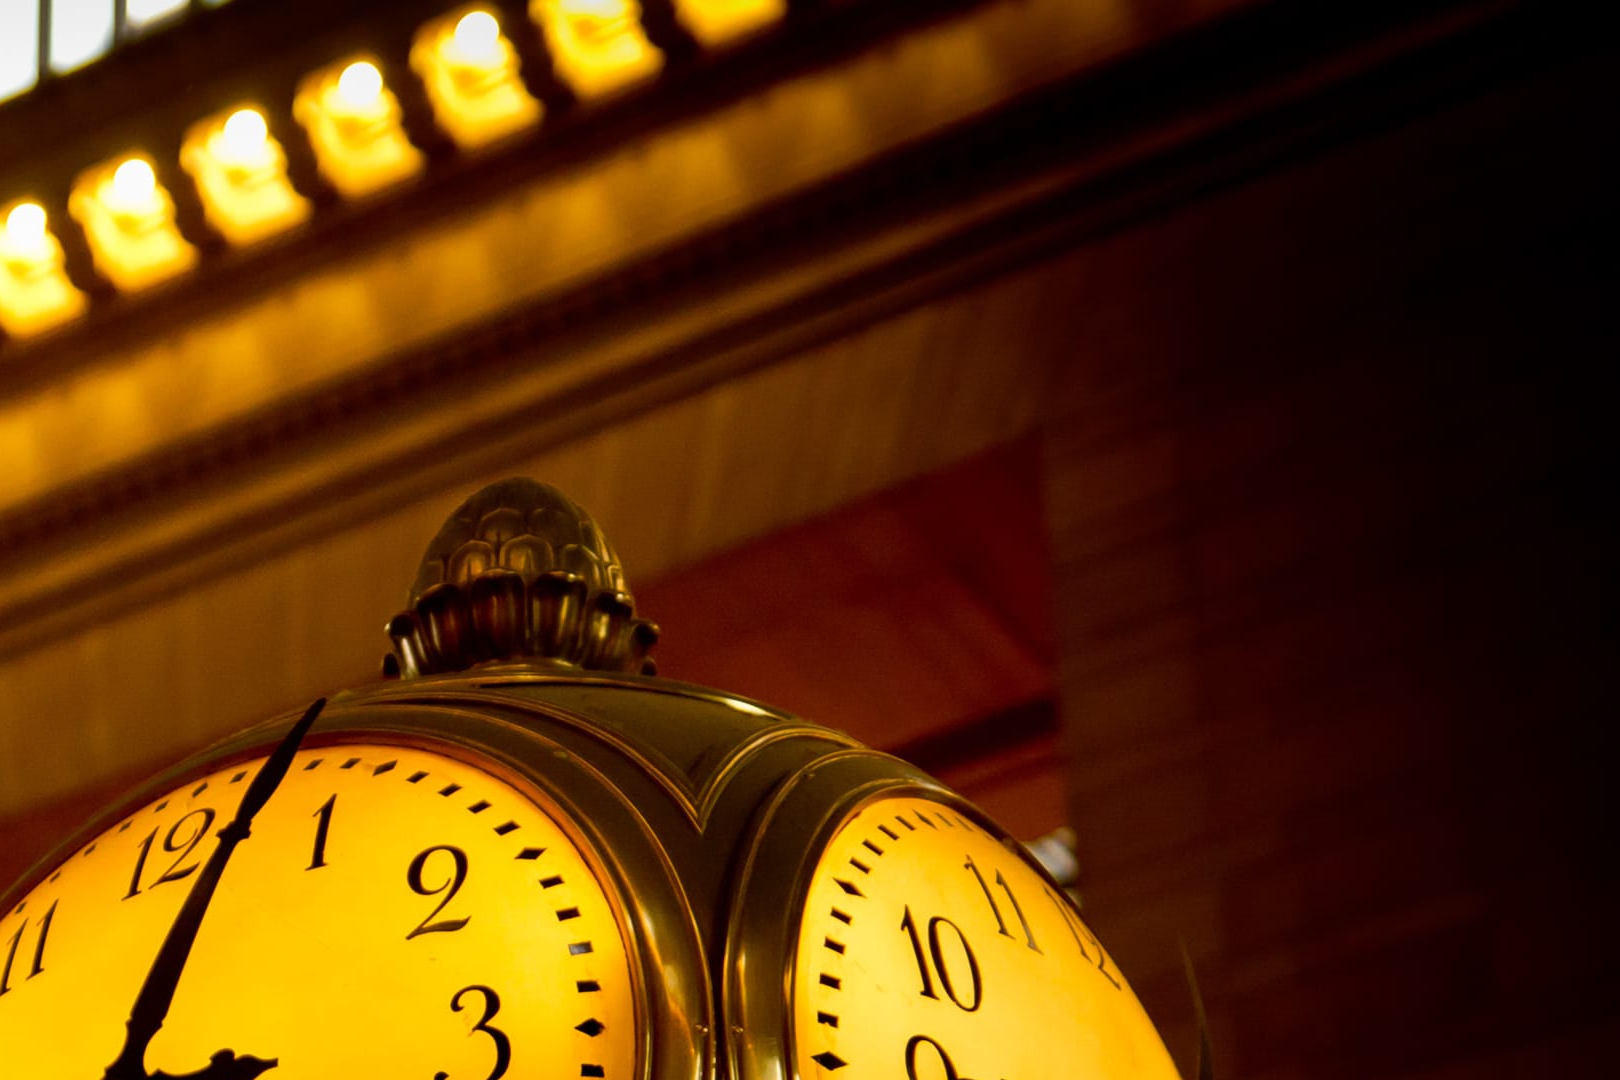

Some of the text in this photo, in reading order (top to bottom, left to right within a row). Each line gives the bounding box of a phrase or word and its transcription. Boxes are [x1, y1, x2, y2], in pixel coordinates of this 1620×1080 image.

[121, 808, 216, 901] 12
[305, 793, 338, 871] 1
[406, 845, 471, 940] 2
[964, 854, 1044, 955] 11
[900, 904, 982, 1013] 10
